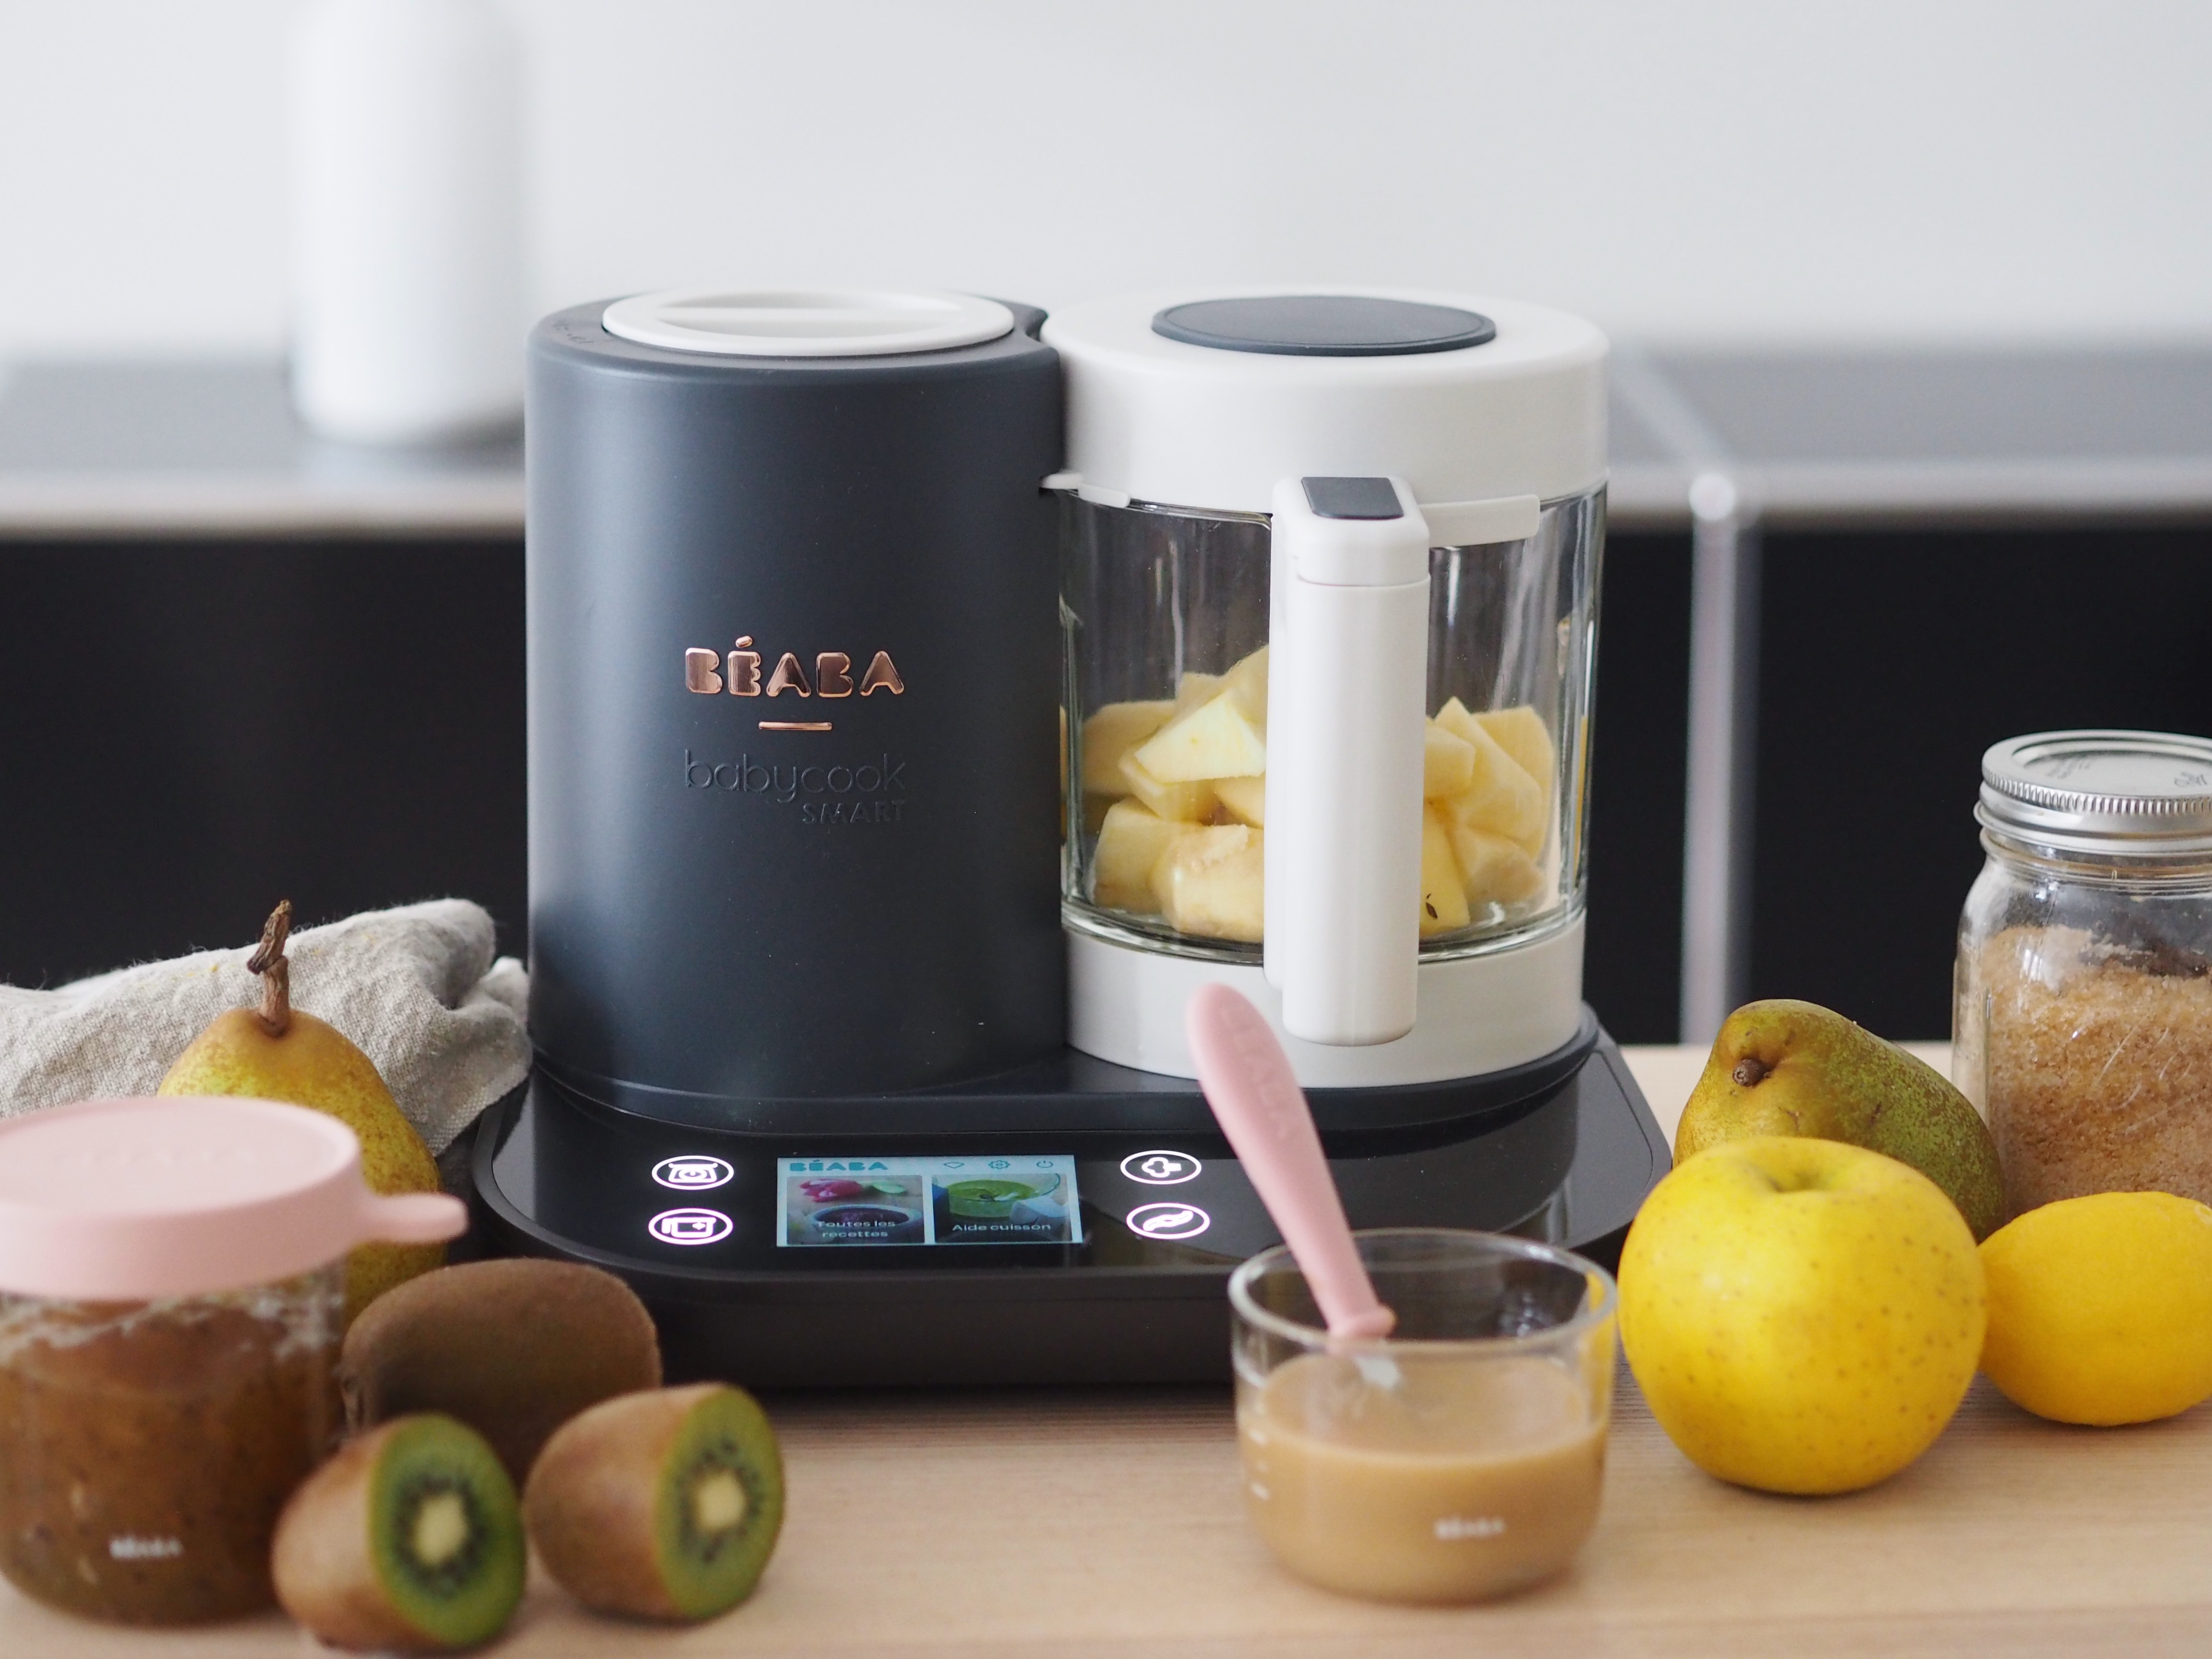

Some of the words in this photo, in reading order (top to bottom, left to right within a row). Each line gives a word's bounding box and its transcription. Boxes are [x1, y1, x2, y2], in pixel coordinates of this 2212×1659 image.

[685, 635, 904, 698] BÉABA
[685, 749, 905, 803] babycook
[802, 800, 905, 825] SMART
[790, 1159, 888, 1171] BÉABA
